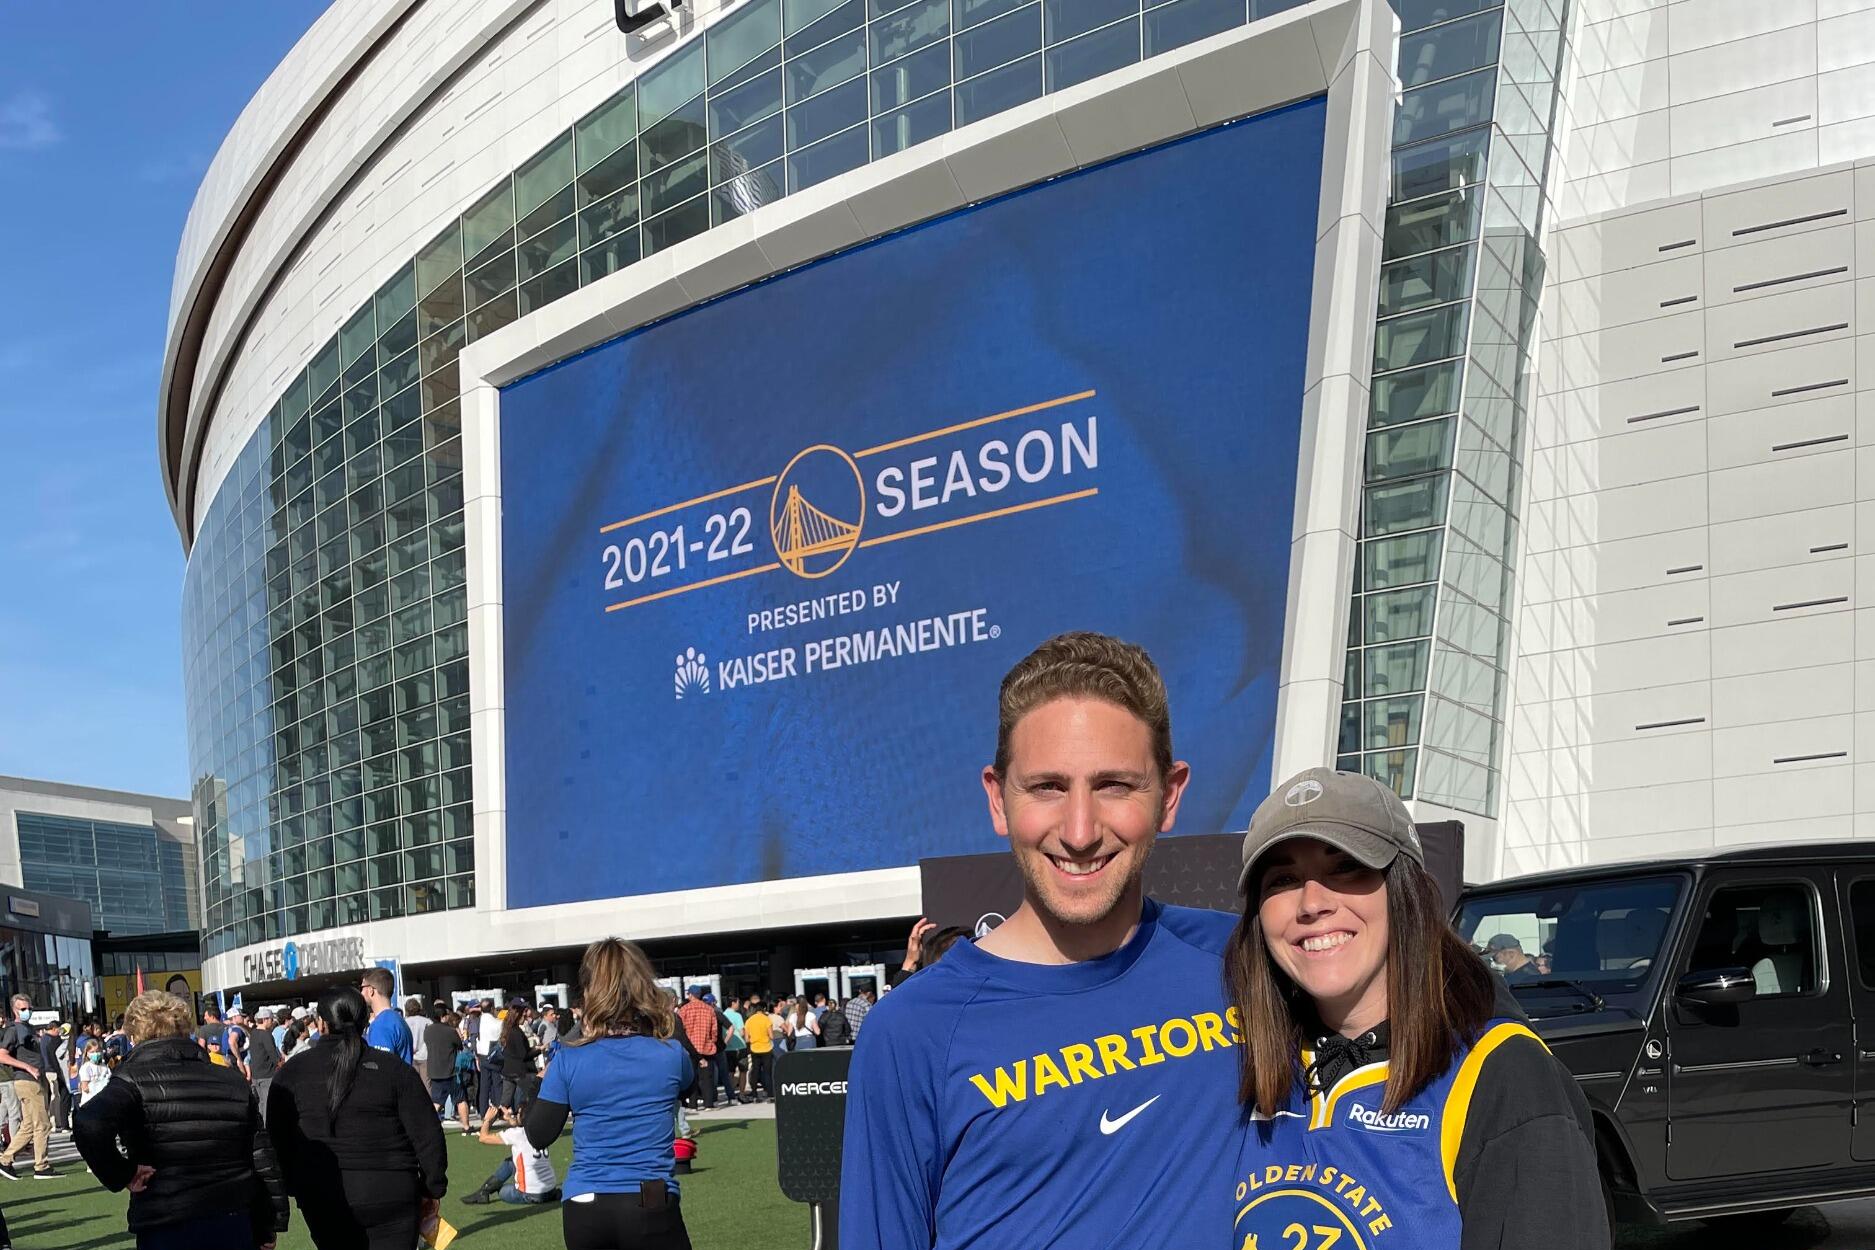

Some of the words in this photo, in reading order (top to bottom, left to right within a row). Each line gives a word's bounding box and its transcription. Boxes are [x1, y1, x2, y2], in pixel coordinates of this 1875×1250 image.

[602, 507, 753, 590] 2021-22
[876, 416, 1098, 517] SEASON
[748, 590, 866, 634] PRESENTED
[873, 580, 901, 608] BY
[718, 647, 797, 690] KAISER
[243, 948, 283, 983] CHASE
[1348, 1103, 1430, 1130] Rakuten
[1235, 1162, 1318, 1202] OLDEN
[1318, 1165, 1393, 1237] STATE
